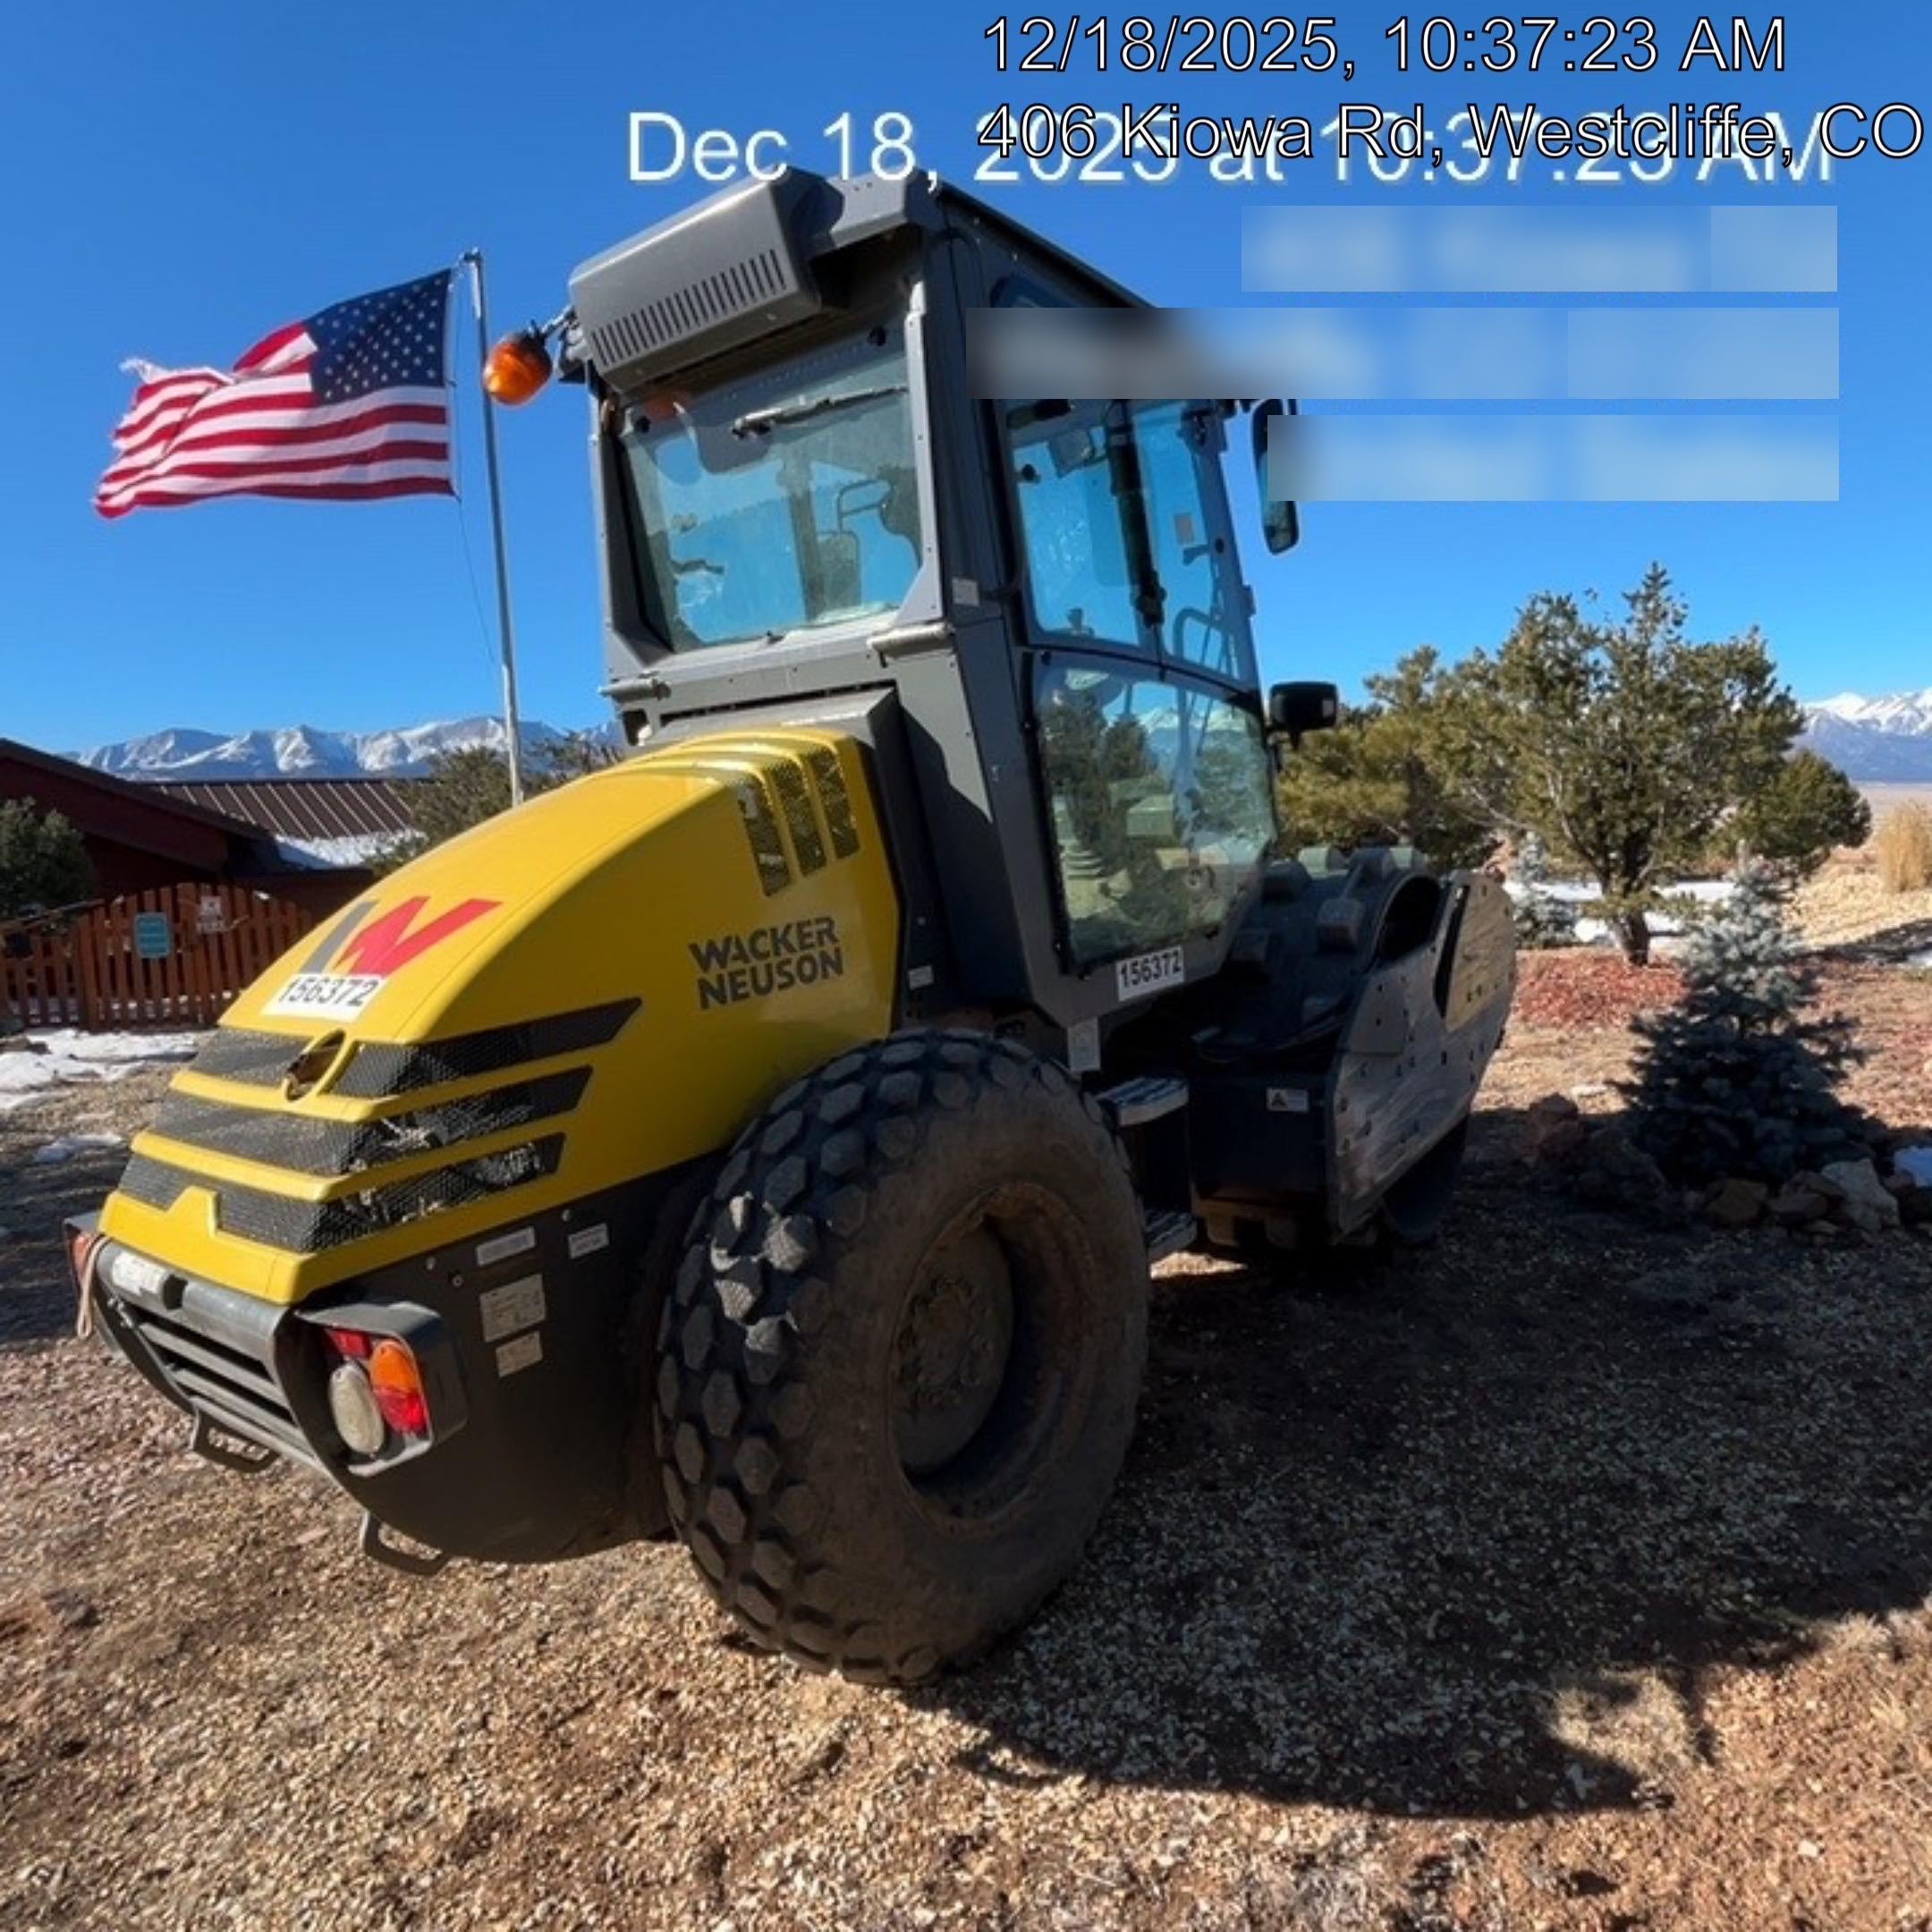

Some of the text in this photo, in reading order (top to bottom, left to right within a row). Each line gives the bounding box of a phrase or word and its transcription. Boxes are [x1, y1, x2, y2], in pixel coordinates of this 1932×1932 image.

[688, 916, 839, 973] WACKER
[1120, 948, 1182, 987] 156372
[278, 976, 379, 1007] 156372
[697, 946, 844, 1010] NEUSON
